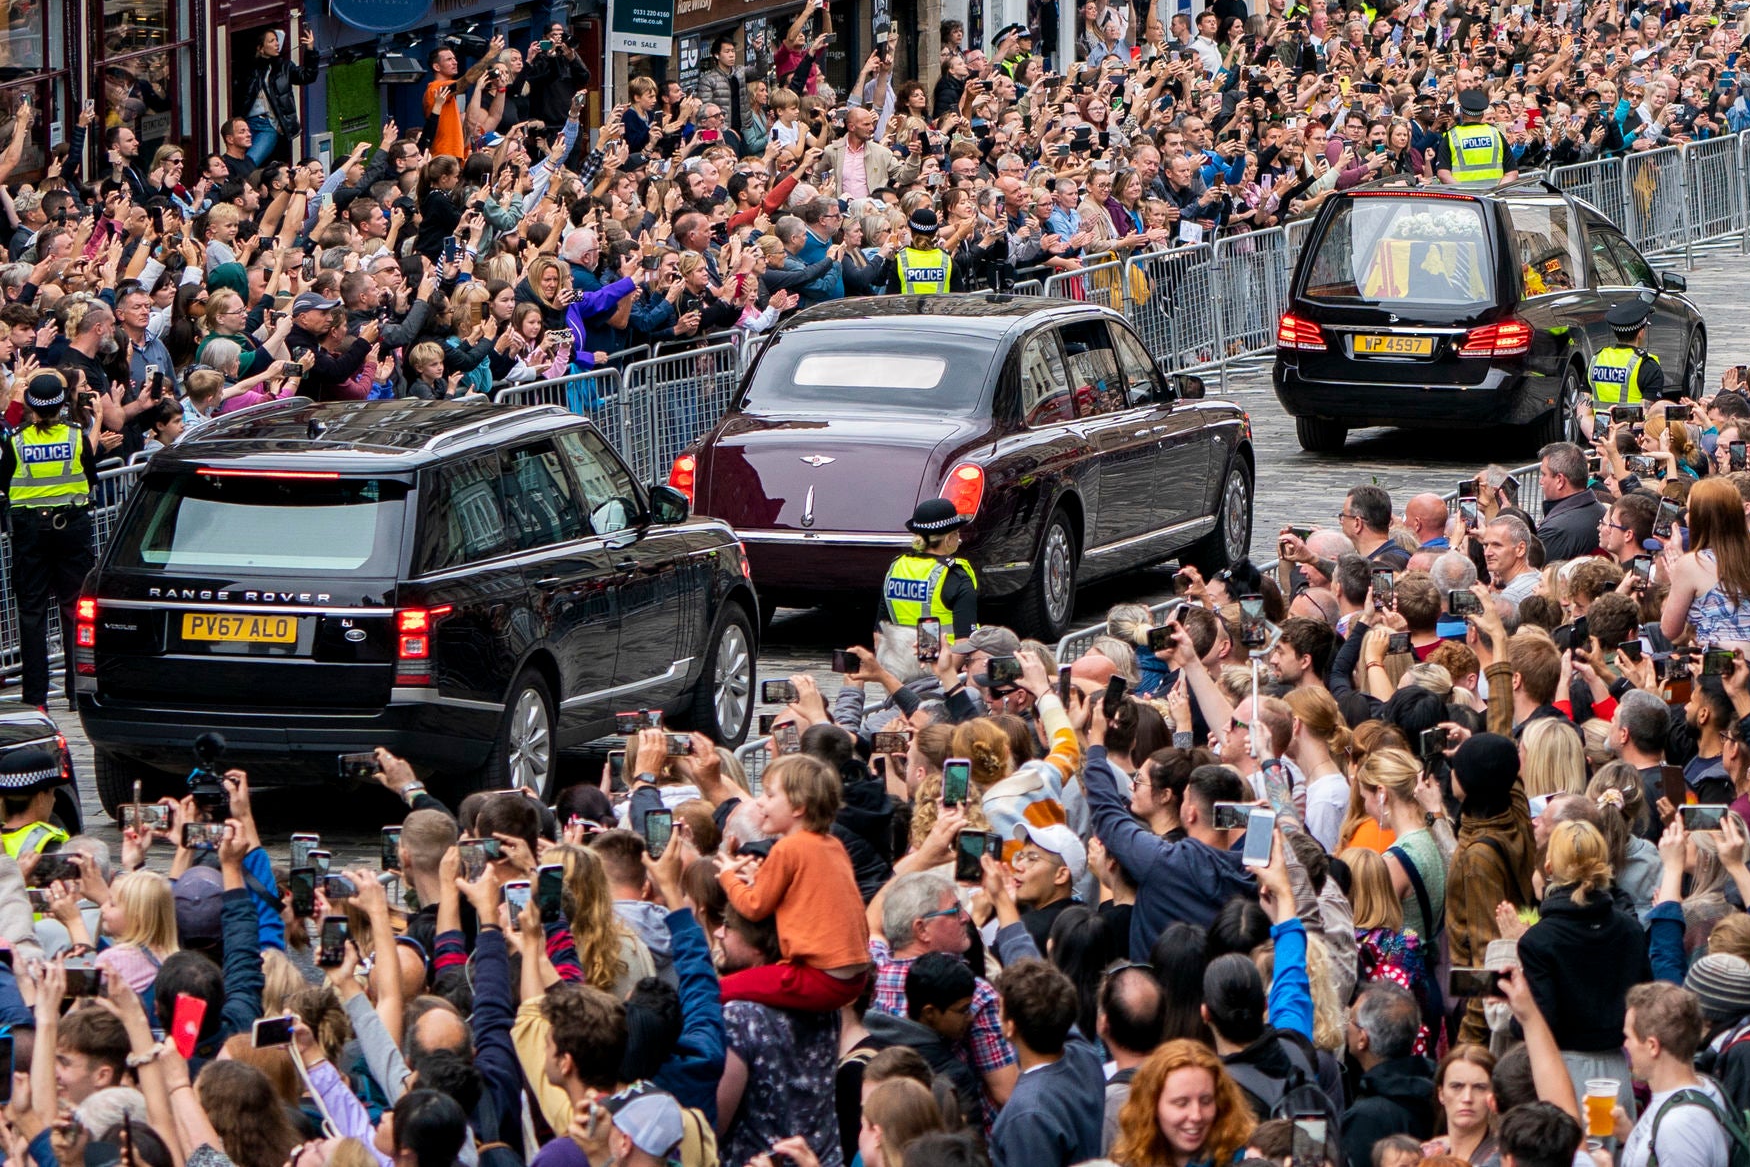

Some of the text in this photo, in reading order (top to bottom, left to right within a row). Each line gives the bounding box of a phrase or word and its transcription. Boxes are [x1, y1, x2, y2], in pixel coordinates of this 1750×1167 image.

[633, 8, 670, 18] 0131 220 4160
[633, 17, 663, 26] rettie.co.uk
[623, 39, 658, 50] FOR SALE
[1463, 137, 1493, 148] POLICE
[908, 269, 943, 281] POLICE
[1365, 335, 1422, 352] WP 4597
[1592, 367, 1626, 382] POLICE
[24, 445, 70, 461] POLICE
[149, 587, 331, 603] RANGE ROVER
[887, 580, 926, 599] POLICE
[191, 616, 288, 638] PV67 ALO
